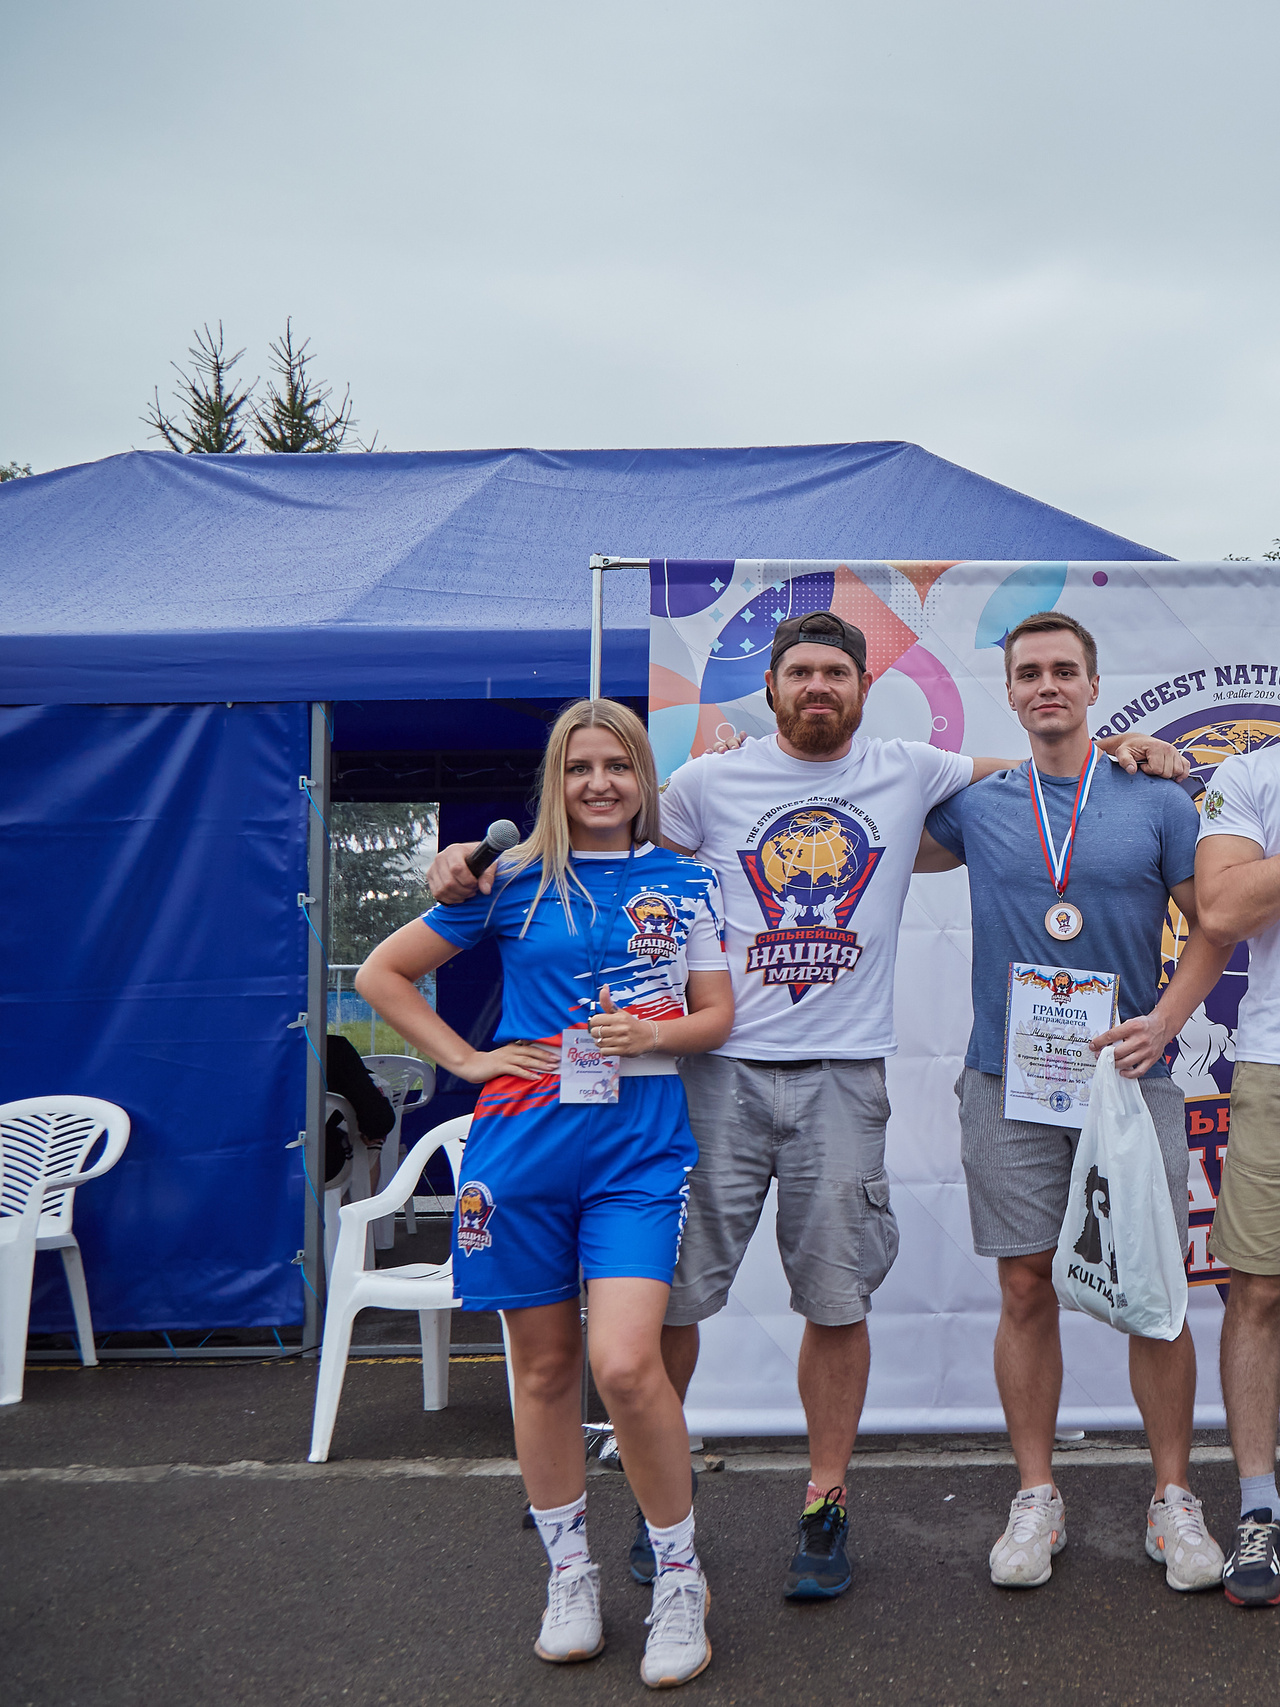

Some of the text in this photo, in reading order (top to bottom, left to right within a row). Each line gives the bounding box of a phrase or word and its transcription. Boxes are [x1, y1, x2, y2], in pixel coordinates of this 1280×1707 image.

[1254, 690, 1275, 699] 2019
[1091, 669, 1207, 741] RONGEST
[746, 827, 760, 844] THE
[849, 803, 865, 817] THE
[863, 814, 881, 841] WORLD
[757, 927, 854, 944] СИЛЬНЕЙШАЯ
[631, 939, 676, 953] НАЦИЯ
[641, 948, 669, 957] МИРА
[749, 942, 860, 969] НАЦИЯ
[767, 966, 834, 982] МИРА
[1033, 1004, 1088, 1020] ГРАМОТА
[1033, 1015, 1086, 1026] награждается
[1045, 1043, 1052, 1053] 3
[1055, 1048, 1082, 1057] МЕСТО
[458, 1231, 488, 1243] АЦИЯ
